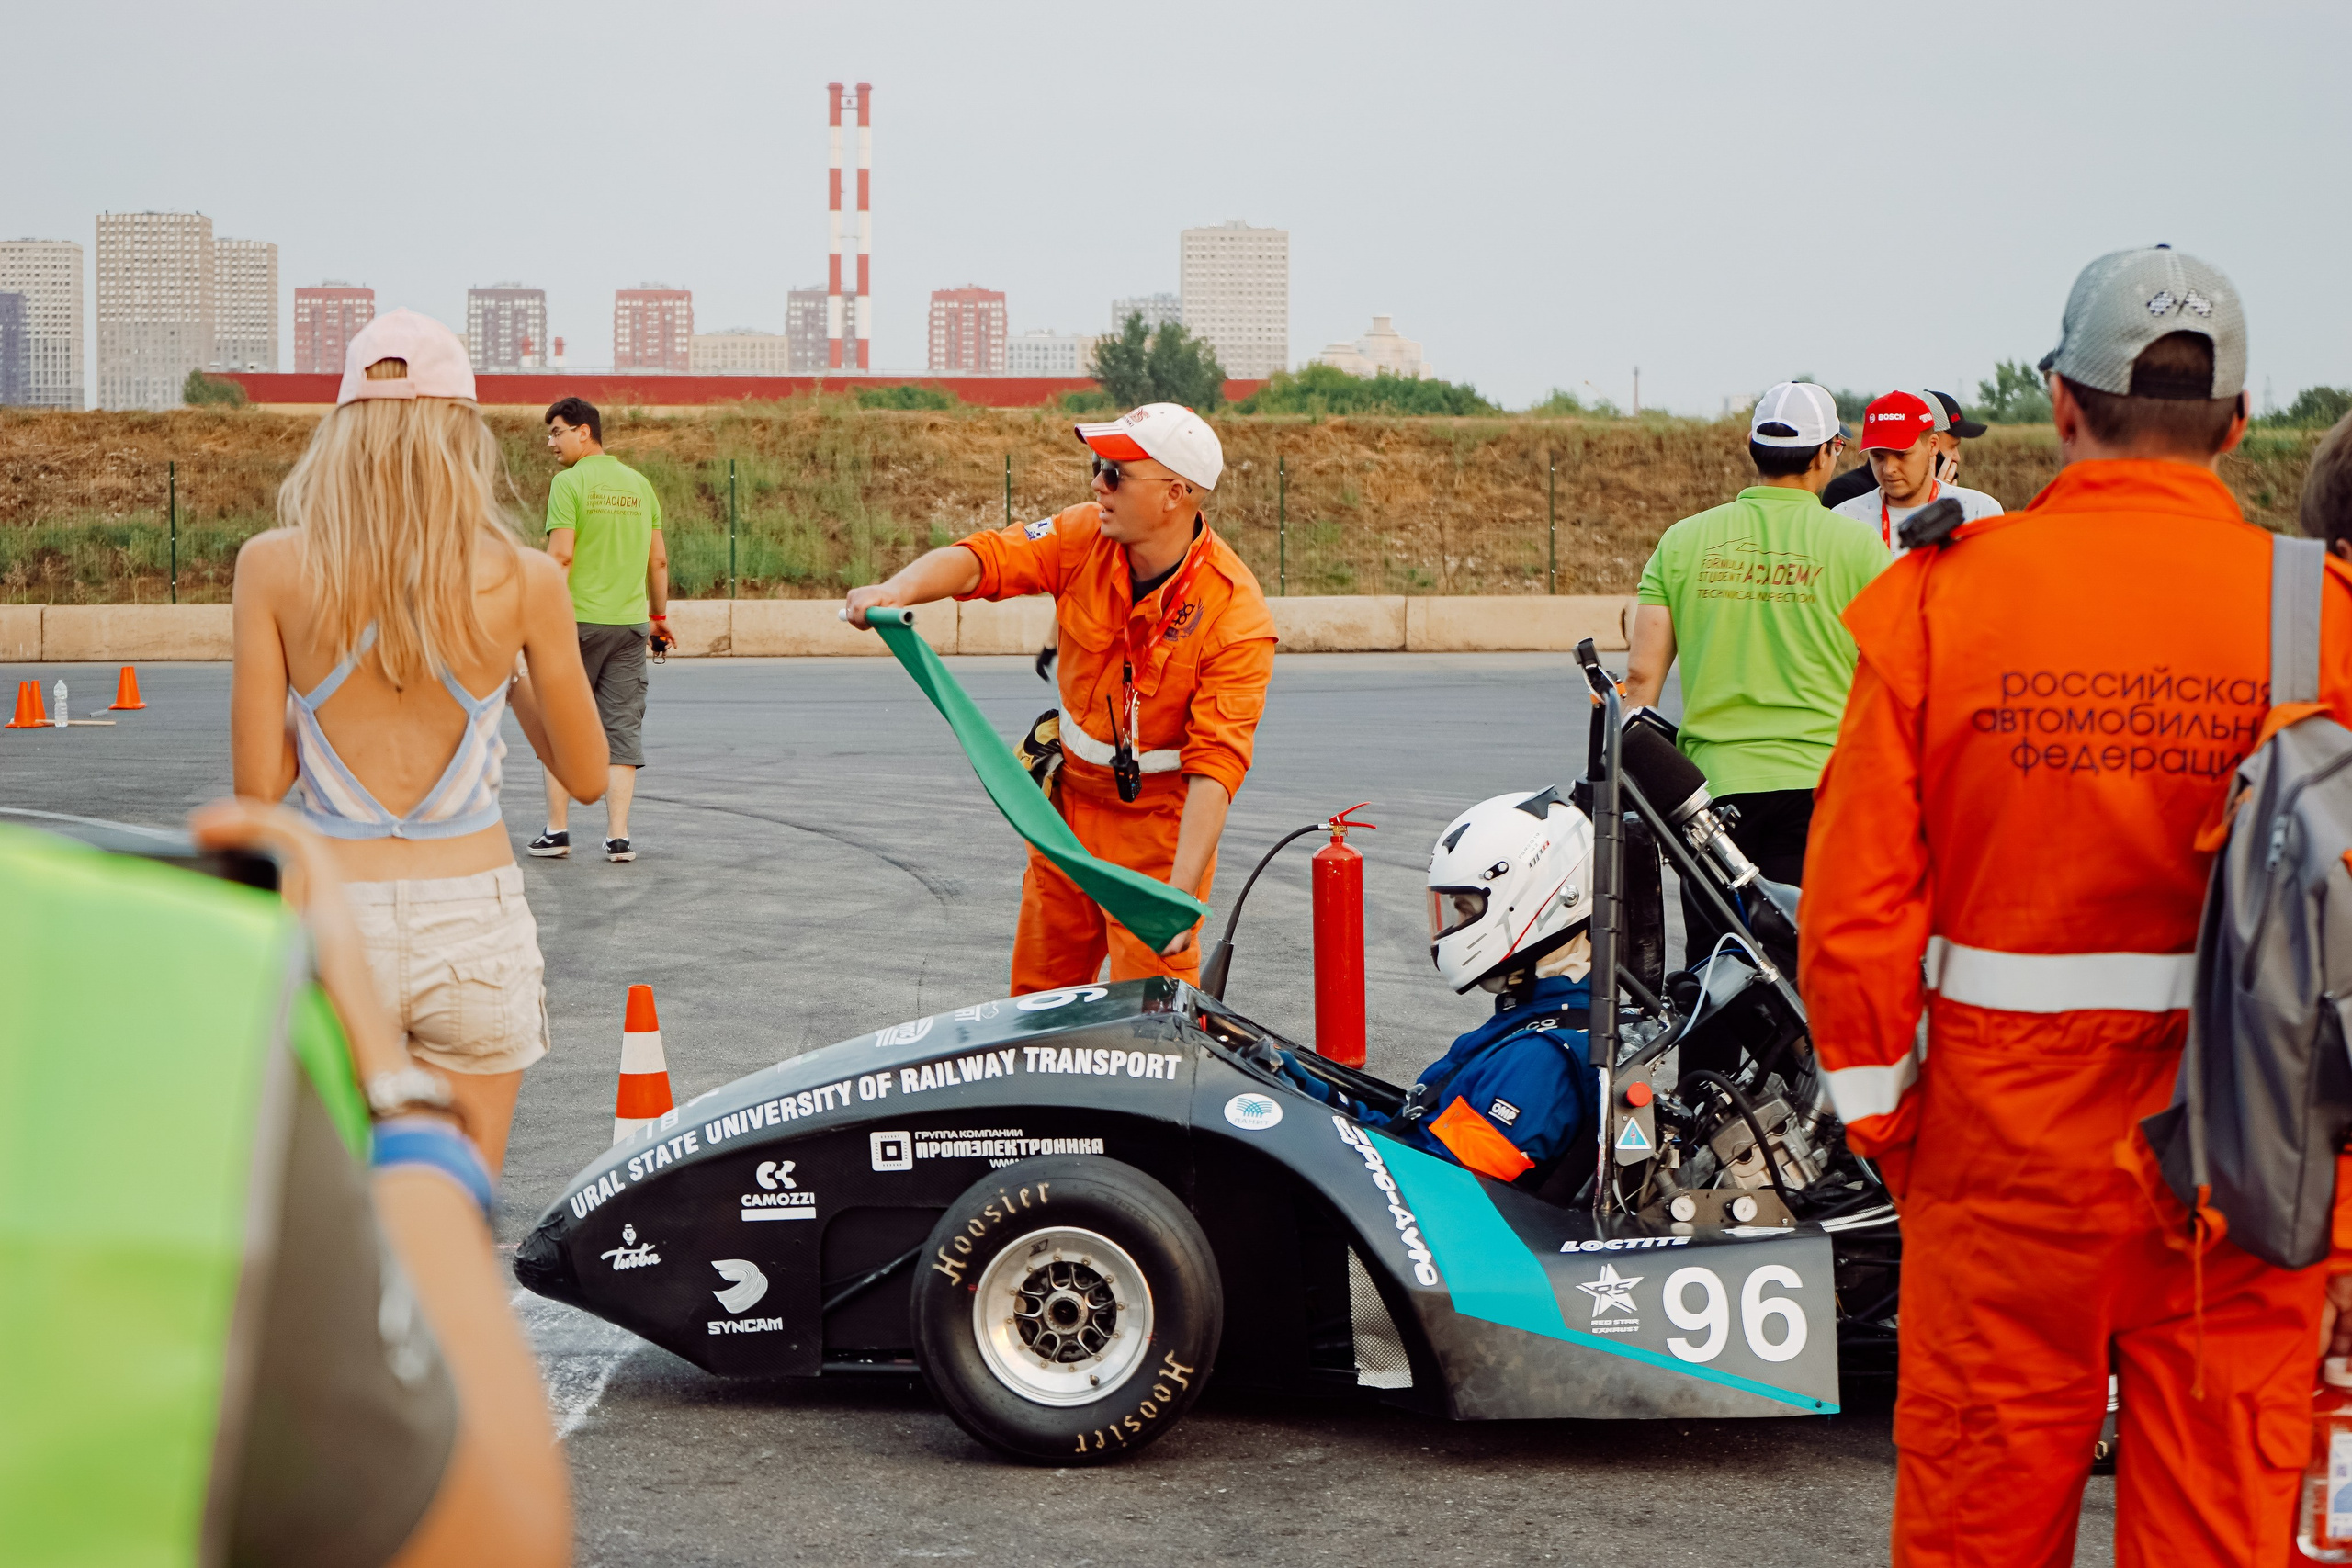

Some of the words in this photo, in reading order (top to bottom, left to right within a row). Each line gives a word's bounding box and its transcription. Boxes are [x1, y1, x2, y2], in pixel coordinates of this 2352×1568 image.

[606, 495, 641, 508] ACADEMY
[1702, 557, 1745, 570] FORMULA
[1698, 571, 1742, 583] STUDENT
[1743, 563, 1824, 587] ACADEMY
[1972, 702, 2257, 742] автомобильн
[2010, 737, 2243, 779] федераци
[1491, 1102, 1517, 1121] OMP
[570, 1170, 626, 1220] URAL
[628, 1130, 699, 1181] STATE
[705, 1080, 852, 1145] UNIVERSITY
[858, 1073, 893, 1101] OF
[900, 1048, 1016, 1094] RAILWAY
[1023, 1046, 1182, 1080] TRANSPORT
[915, 1130, 958, 1140] ГРУППА
[959, 1129, 1023, 1139] КОМПАНИИ
[916, 1138, 1104, 1158] ПРОМЭЛЕКТРОНИКА
[741, 1192, 816, 1207] CAMOZZI
[932, 1182, 1049, 1286] Hoosier
[1560, 1235, 1692, 1253] LOCTITE
[1662, 1264, 1808, 1363] 96
[707, 1317, 783, 1335] SYNCAM
[1074, 1349, 1194, 1452] Hoosier
